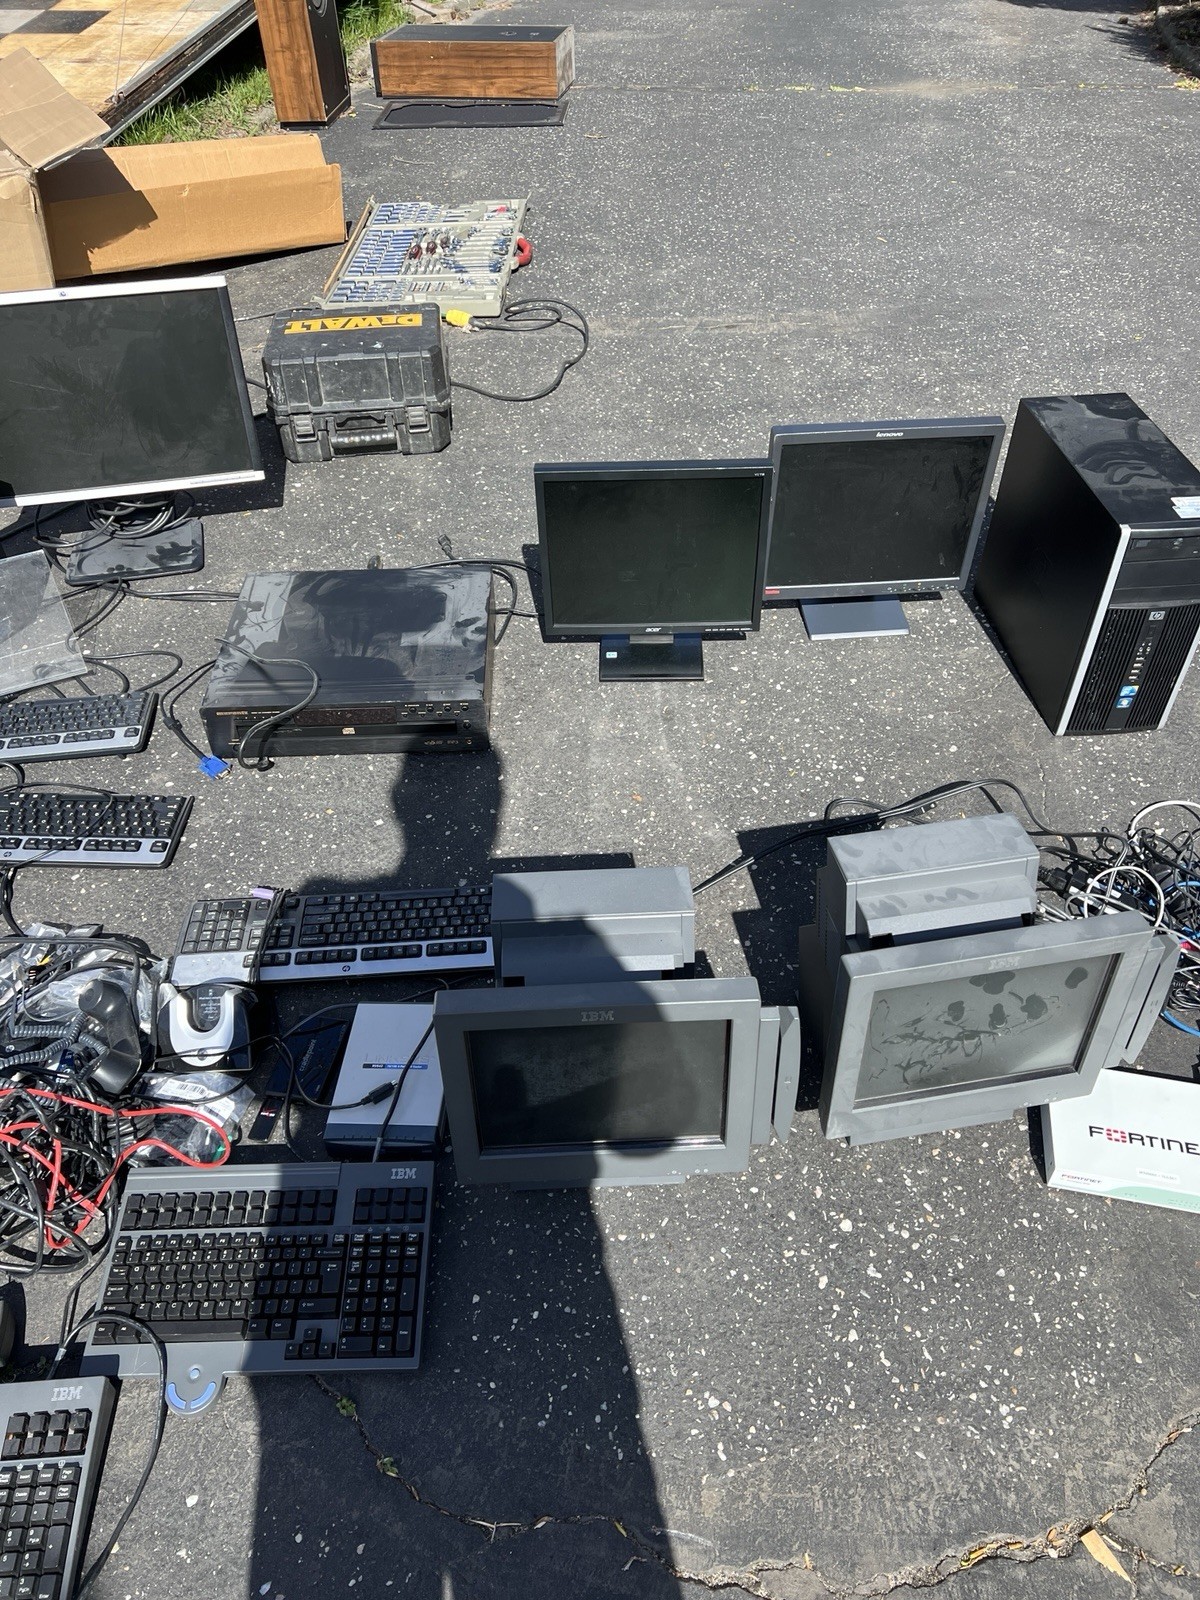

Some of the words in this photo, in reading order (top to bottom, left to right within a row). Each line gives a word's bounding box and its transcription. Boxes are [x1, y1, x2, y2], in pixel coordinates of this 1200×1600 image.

[581, 1010, 614, 1022] IBM
[391, 1168, 417, 1179] IBM
[51, 1386, 82, 1401] IBM
